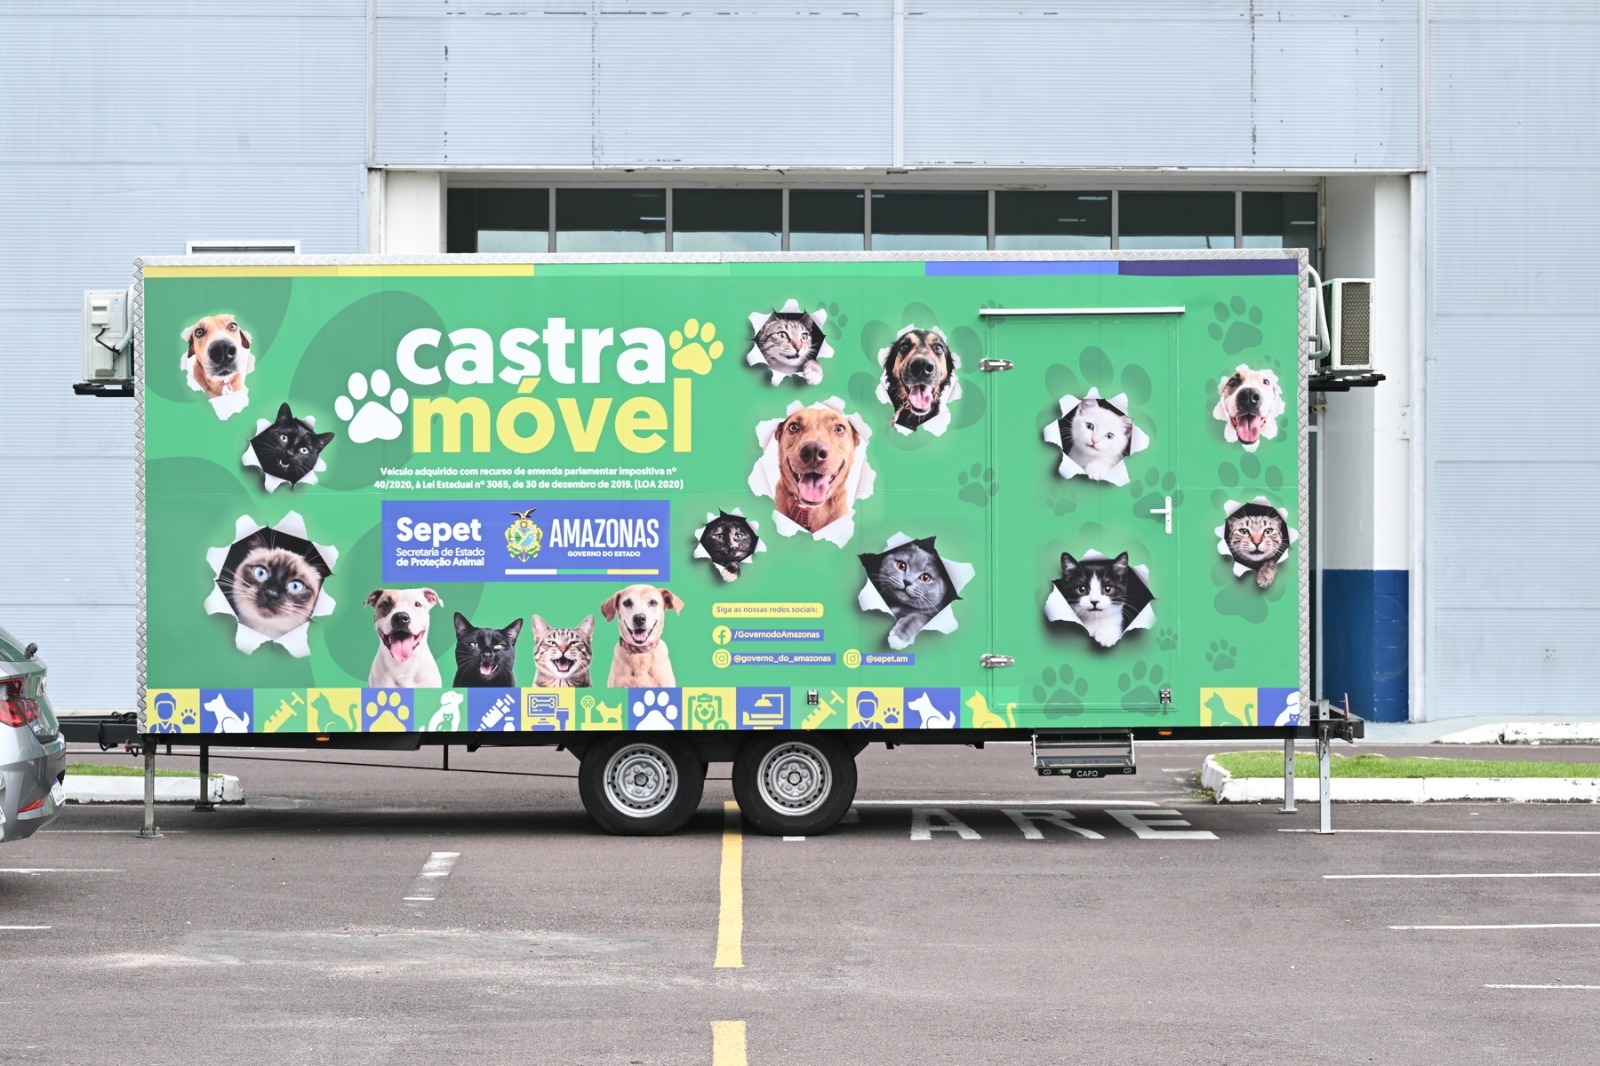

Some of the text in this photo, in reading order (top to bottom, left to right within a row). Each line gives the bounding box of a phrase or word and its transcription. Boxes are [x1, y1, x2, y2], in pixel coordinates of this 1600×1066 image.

[396, 317, 666, 385] castra
[413, 377, 692, 454] móvel
[380, 467, 414, 476] Veículo
[415, 467, 458, 477] adquirido
[514, 467, 525, 476] de
[527, 467, 562, 476] emenda
[564, 467, 618, 477] parlamentar
[619, 467, 664, 477] impositiva
[374, 480, 414, 490] 40/2020,
[423, 480, 435, 489] Lei
[436, 480, 474, 489] Estadual
[487, 480, 511, 490] 3065,
[512, 480, 524, 489] de
[526, 480, 536, 489] 30
[538, 480, 550, 489] de
[552, 480, 596, 489] dezembro
[598, 480, 609, 489] de
[611, 480, 632, 489] 2019.
[396, 516, 482, 547] Sepet
[549, 518, 659, 548] AMAZONAS
[396, 548, 485, 557] Secretaria de Estado
[568, 550, 640, 558] GOVERNO DO ESTADO
[396, 558, 484, 568] de Proteção Animal
[716, 605, 732, 614] Siga
[770, 605, 789, 613] redes
[791, 605, 818, 613] sociais:
[734, 630, 820, 640] /GovernodoAmazonas
[866, 655, 908, 664] @sepet.am
[783, 808, 1220, 840] ARE
